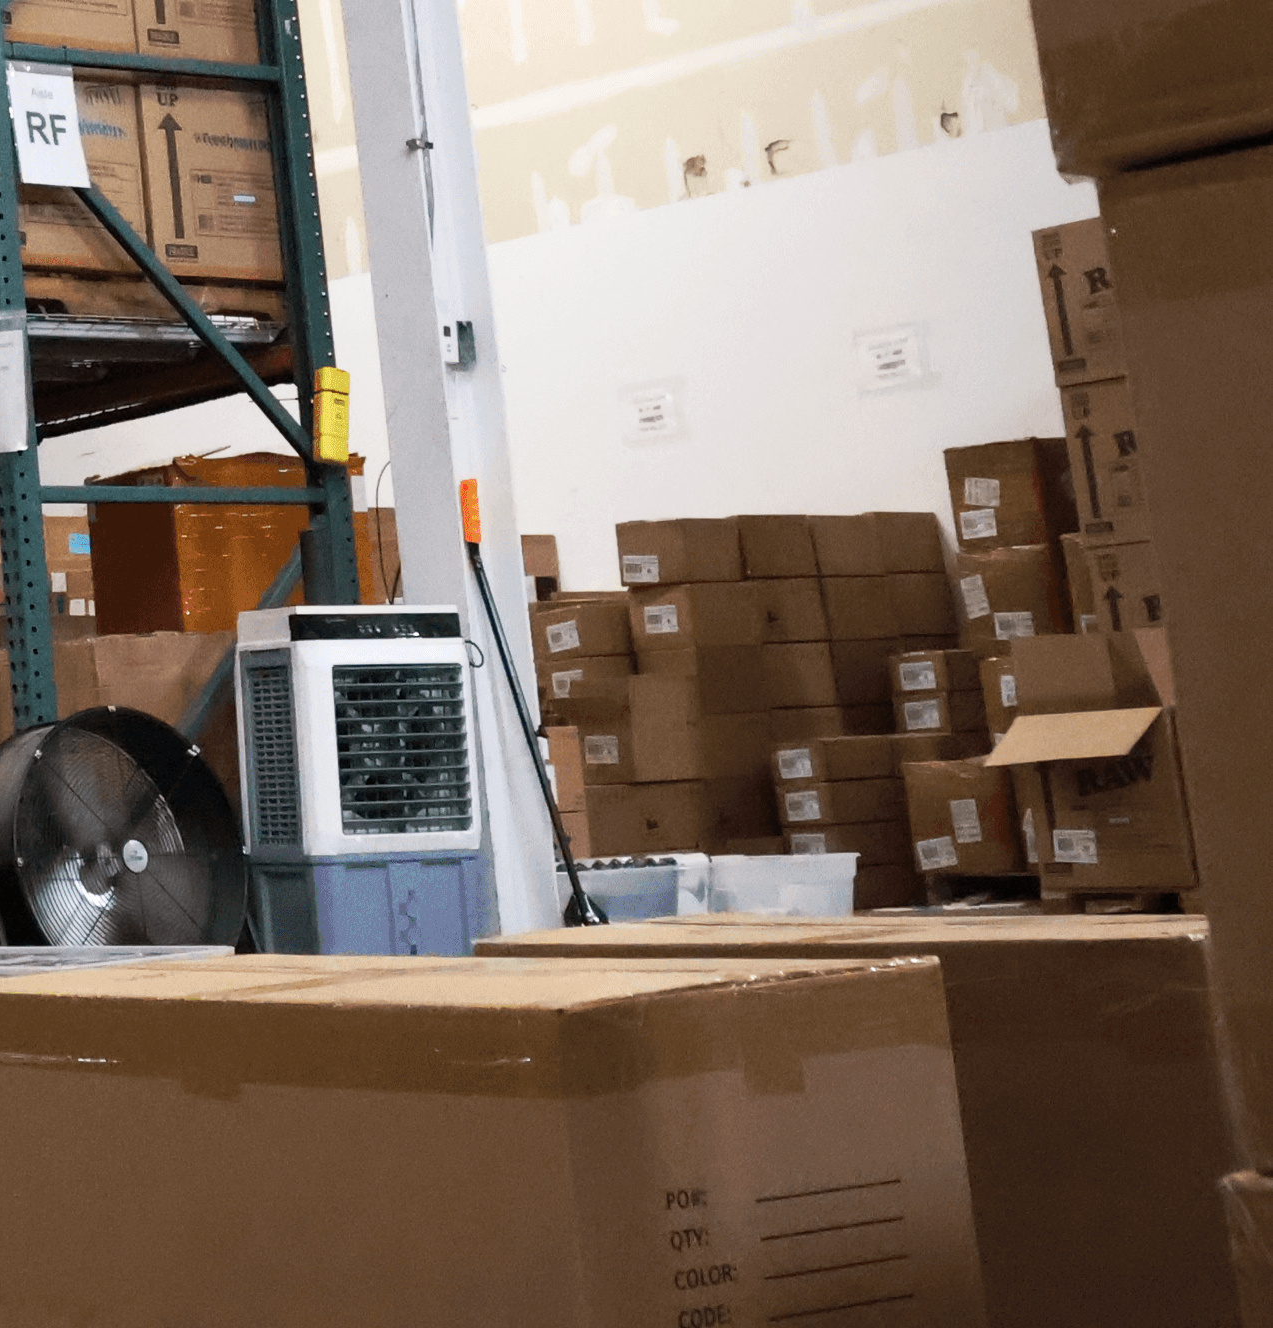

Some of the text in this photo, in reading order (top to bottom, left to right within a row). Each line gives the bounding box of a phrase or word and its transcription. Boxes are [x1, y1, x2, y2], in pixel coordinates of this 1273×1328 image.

[157, 92, 178, 107] UP
[26, 110, 66, 146] RF
[671, 1228, 708, 1252] QTY:
[675, 1263, 737, 1290] COLOR:
[678, 1304, 733, 1328] CODE:
